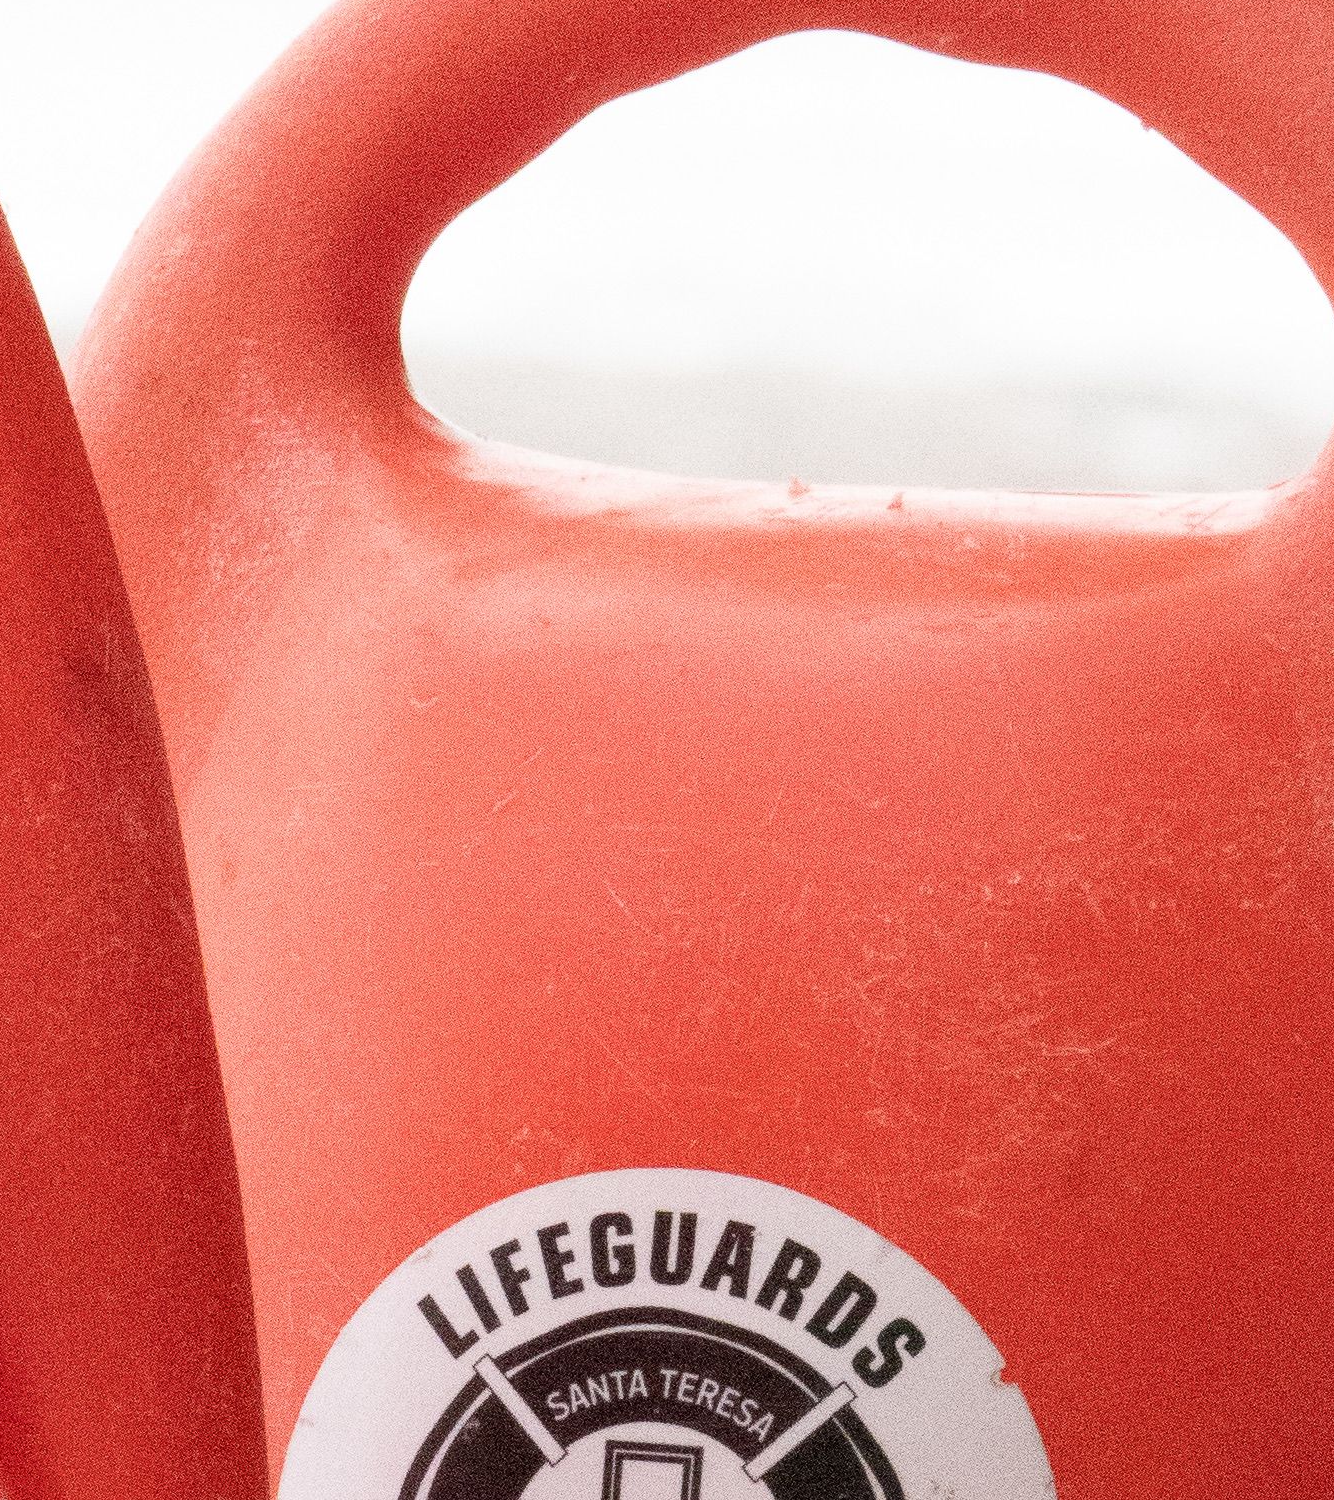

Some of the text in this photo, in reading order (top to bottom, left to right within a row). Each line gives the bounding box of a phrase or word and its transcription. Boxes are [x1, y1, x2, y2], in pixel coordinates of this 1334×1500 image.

[416, 1209, 927, 1389] LIFEGUARDS
[547, 1368, 777, 1443] SANTA TERESA
